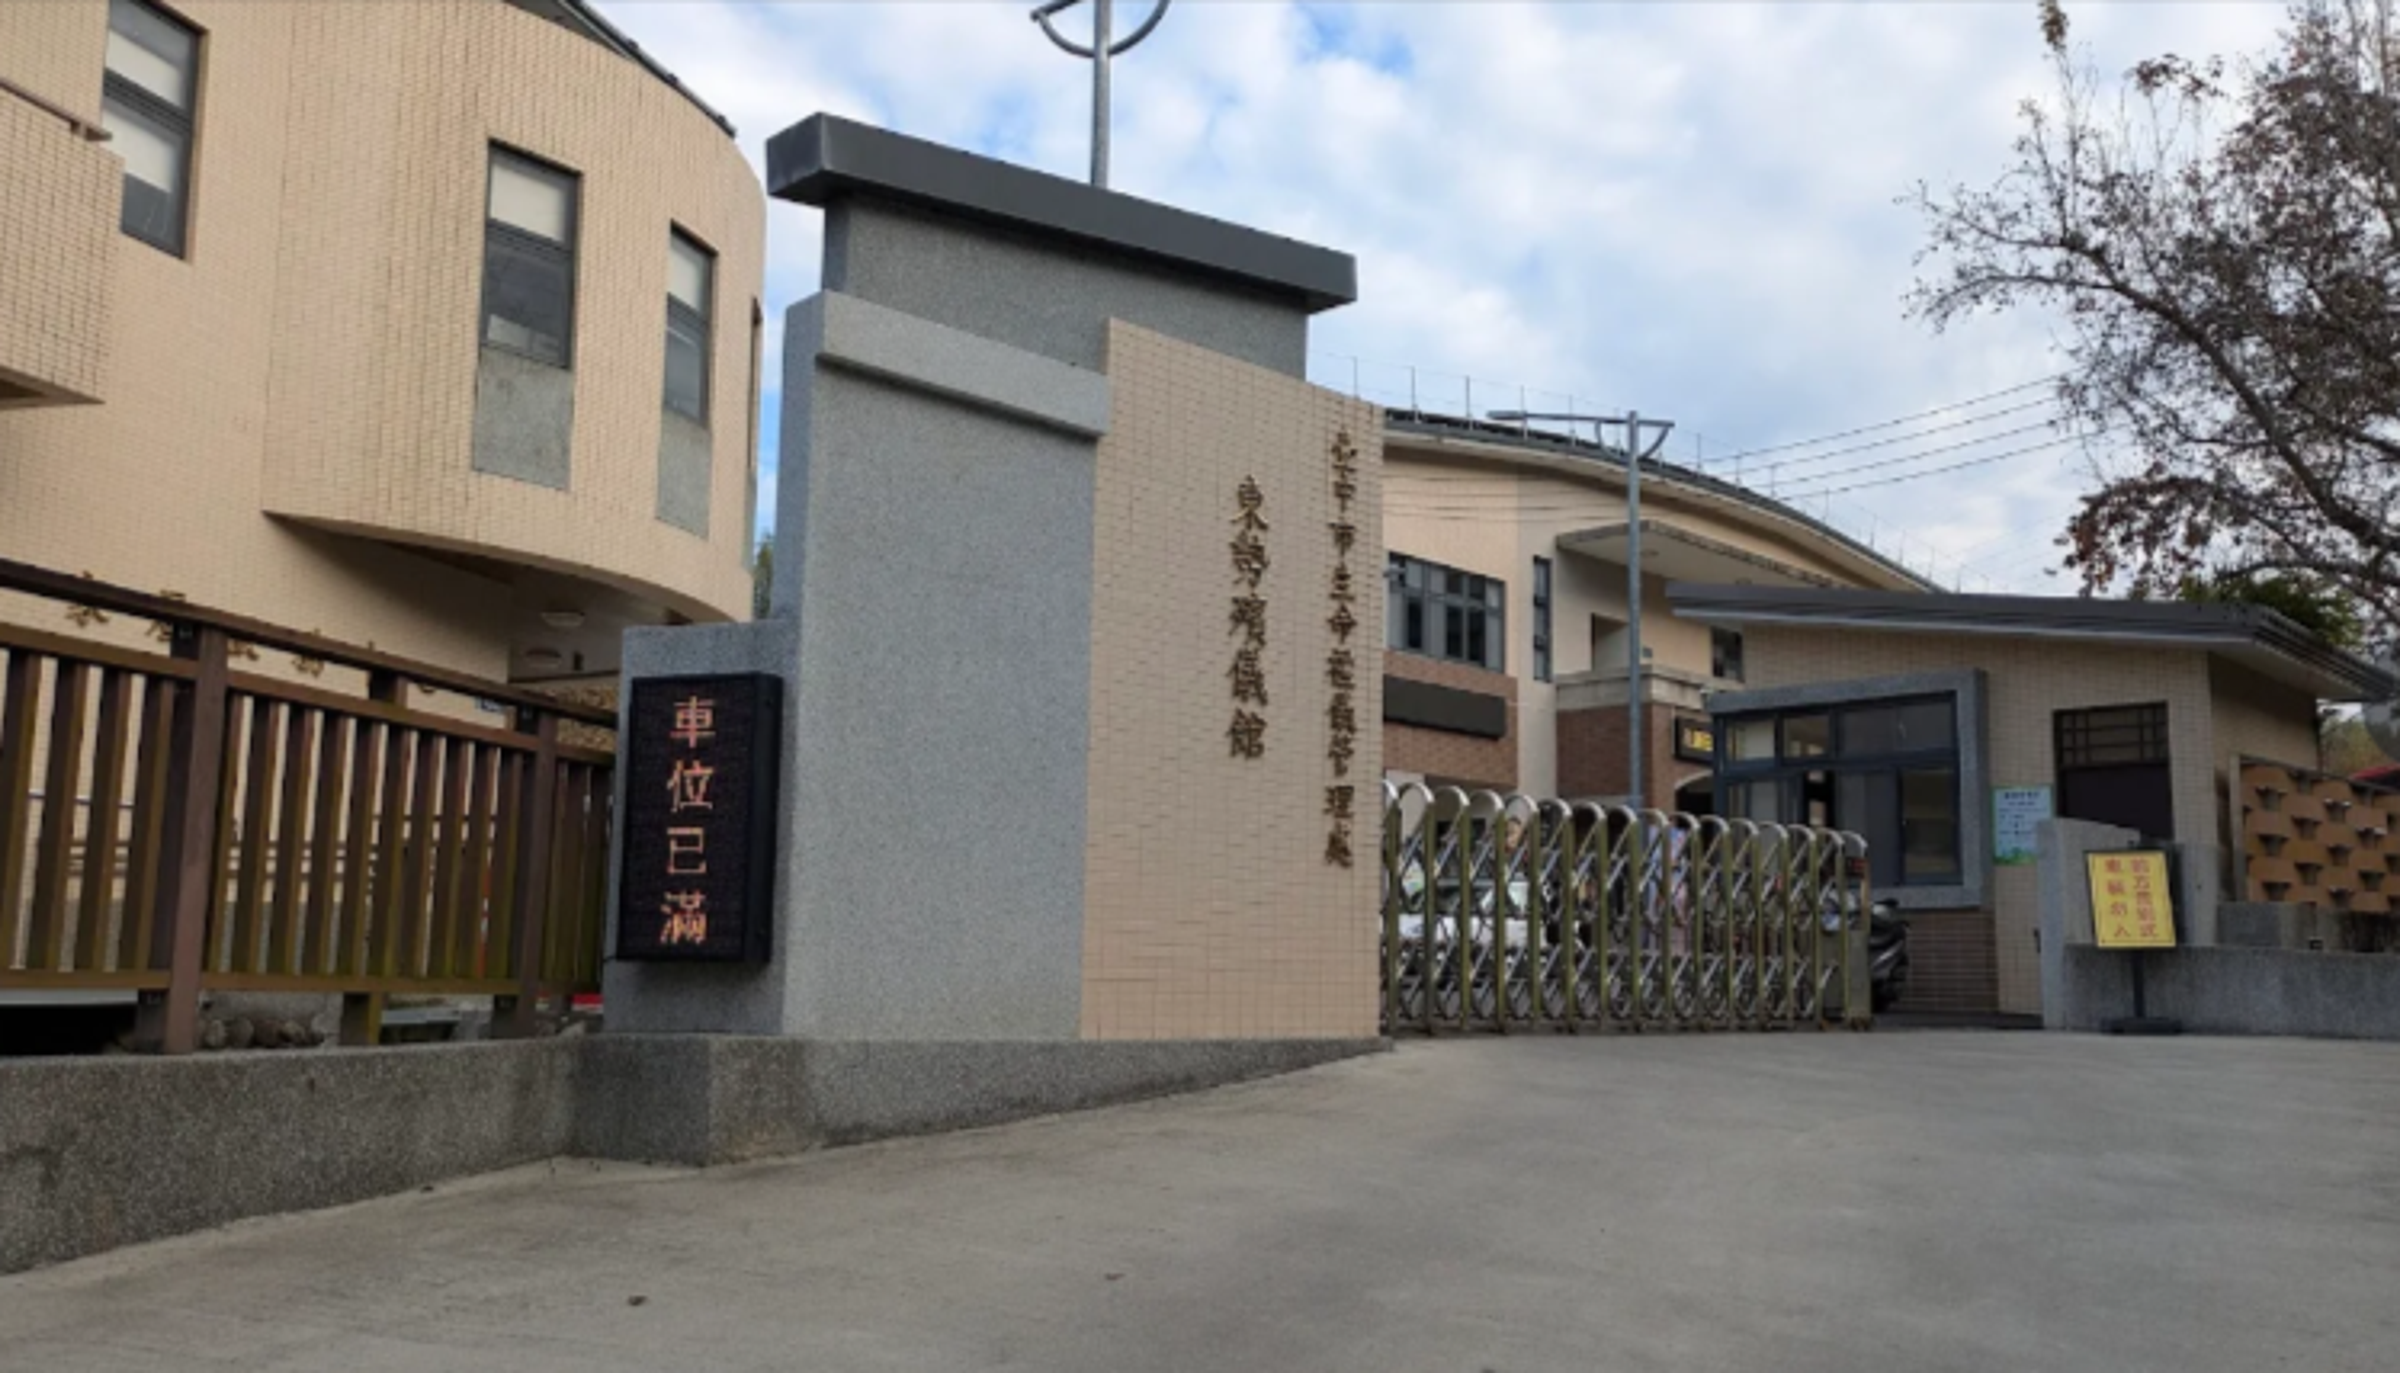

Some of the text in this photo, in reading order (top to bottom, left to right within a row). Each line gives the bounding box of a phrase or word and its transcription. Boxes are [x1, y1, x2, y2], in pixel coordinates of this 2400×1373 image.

[1226, 474, 1270, 761] 東勢殯儀館
[660, 696, 716, 944] 車位已滿
